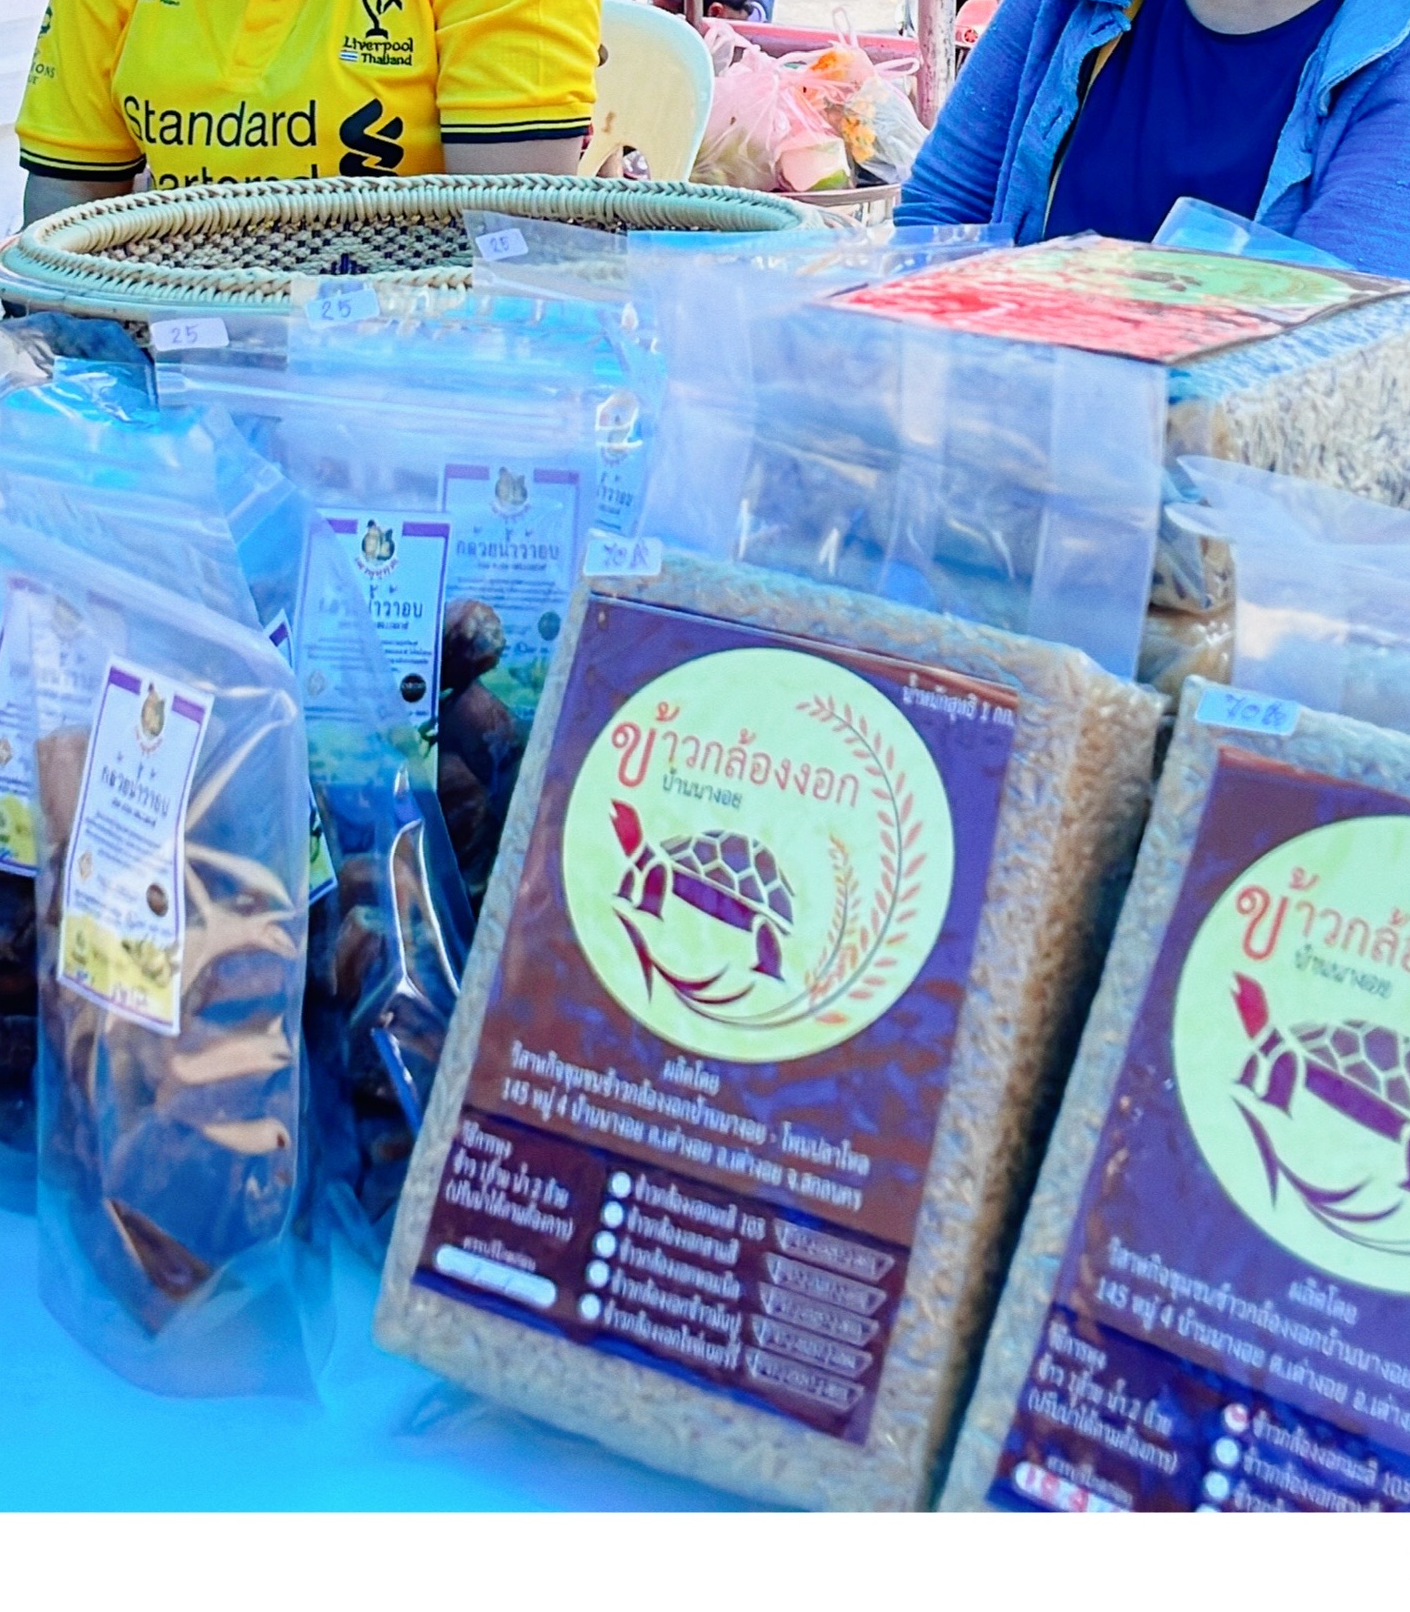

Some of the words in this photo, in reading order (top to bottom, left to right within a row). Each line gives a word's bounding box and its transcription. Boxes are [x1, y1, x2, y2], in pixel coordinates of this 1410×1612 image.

[342, 35, 414, 56] Liverpool
[360, 52, 413, 67] Thailand
[122, 94, 318, 148] Standard
[322, 297, 352, 320] 25
[172, 325, 198, 345] 25
[611, 700, 860, 811] ข้าวกล้องงอก
